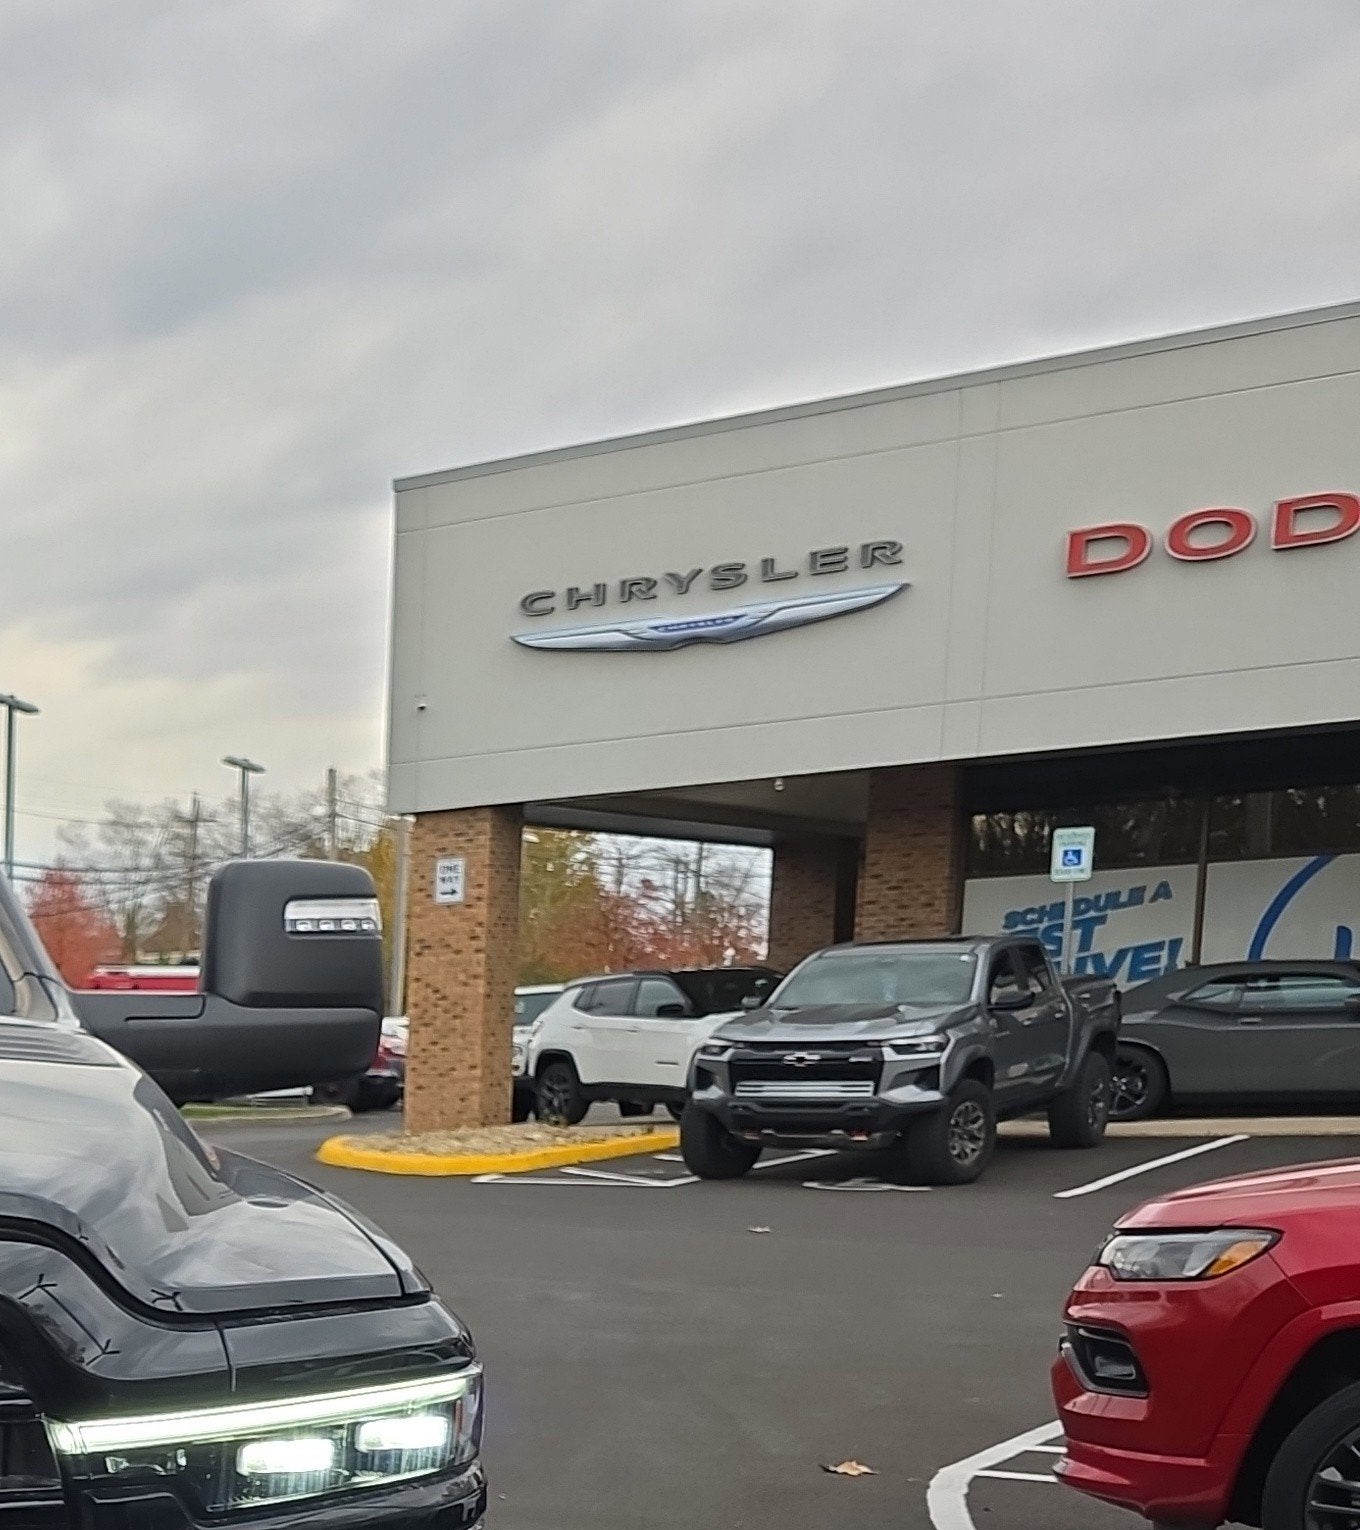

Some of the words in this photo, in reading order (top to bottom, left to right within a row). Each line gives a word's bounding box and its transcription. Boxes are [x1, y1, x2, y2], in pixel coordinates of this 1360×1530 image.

[520, 539, 903, 617] CHRYSLER
[1148, 880, 1173, 904] A
[1054, 936, 1184, 983] IVE!
